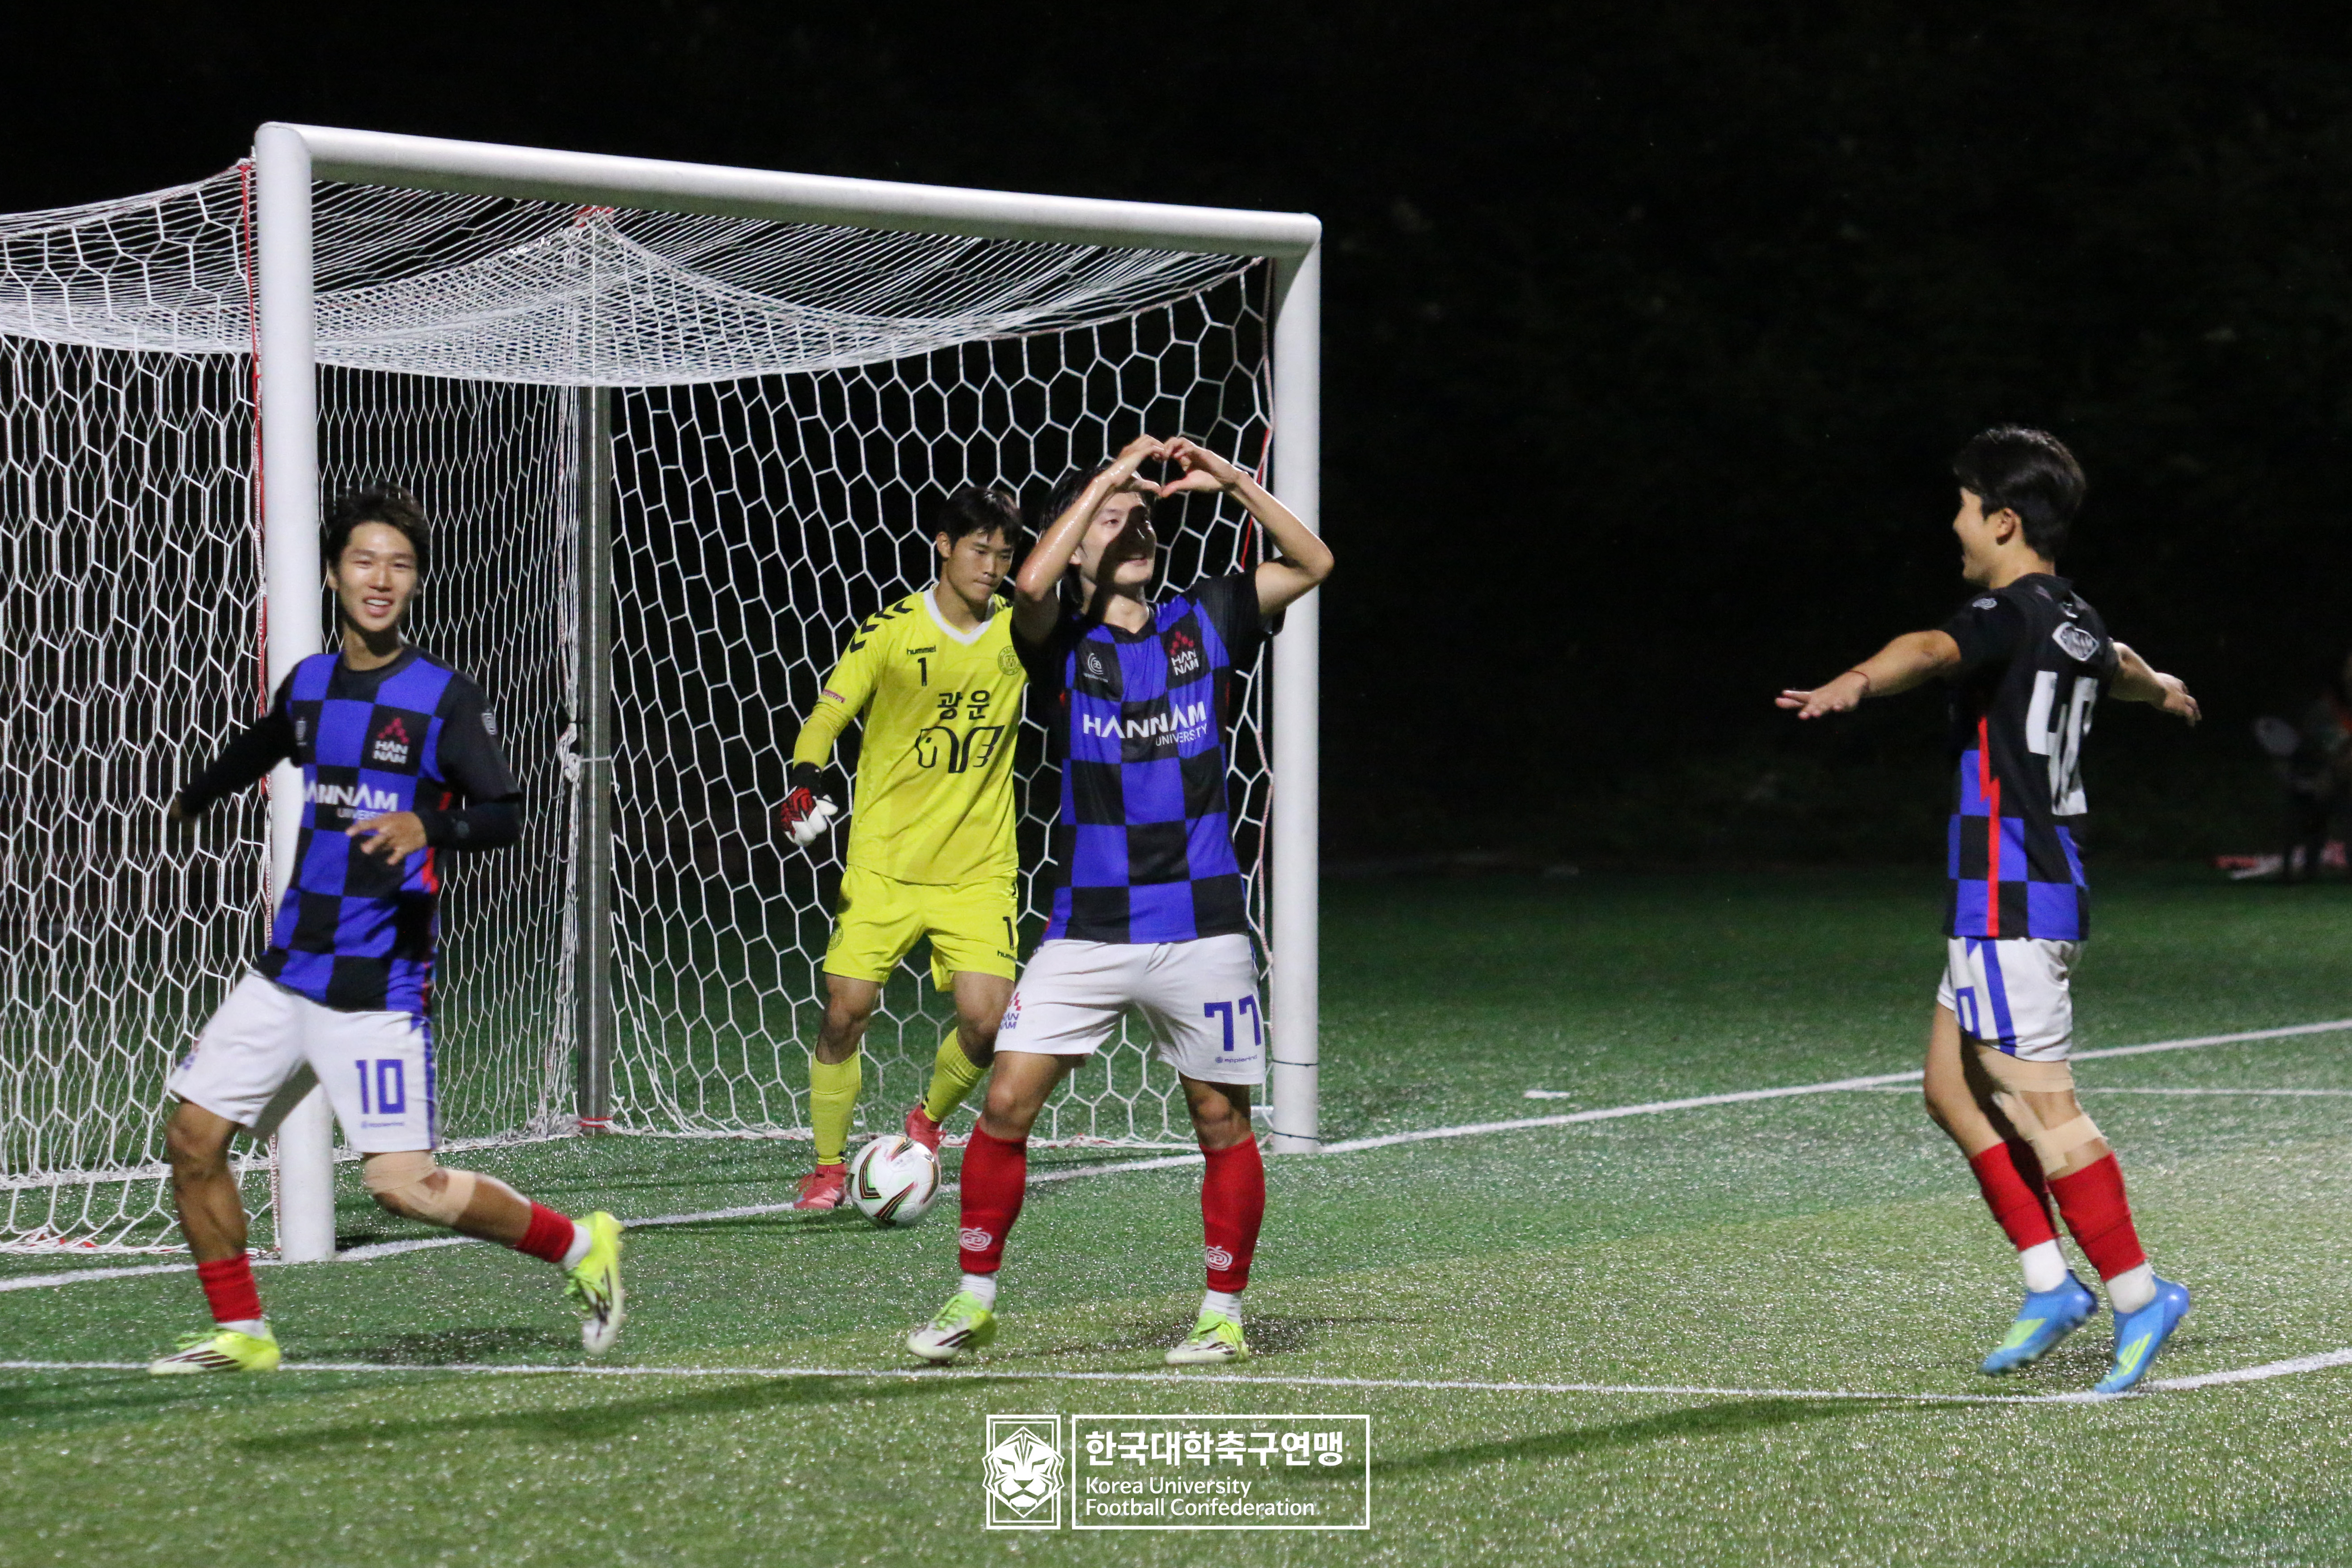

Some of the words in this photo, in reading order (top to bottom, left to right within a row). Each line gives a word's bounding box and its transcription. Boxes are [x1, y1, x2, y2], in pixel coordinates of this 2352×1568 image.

[907, 645, 937, 655] hummel
[1171, 649, 1197, 666] HAN
[918, 657, 927, 686] 1
[1174, 658, 1199, 676] NAM
[937, 690, 990, 720] 광운
[1083, 701, 1207, 738] HANNAM
[372, 749, 407, 764] NAM
[375, 740, 408, 754] HAN
[1003, 916, 1014, 951] 1
[1204, 994, 1261, 1051] 77
[355, 1059, 405, 1115] 10
